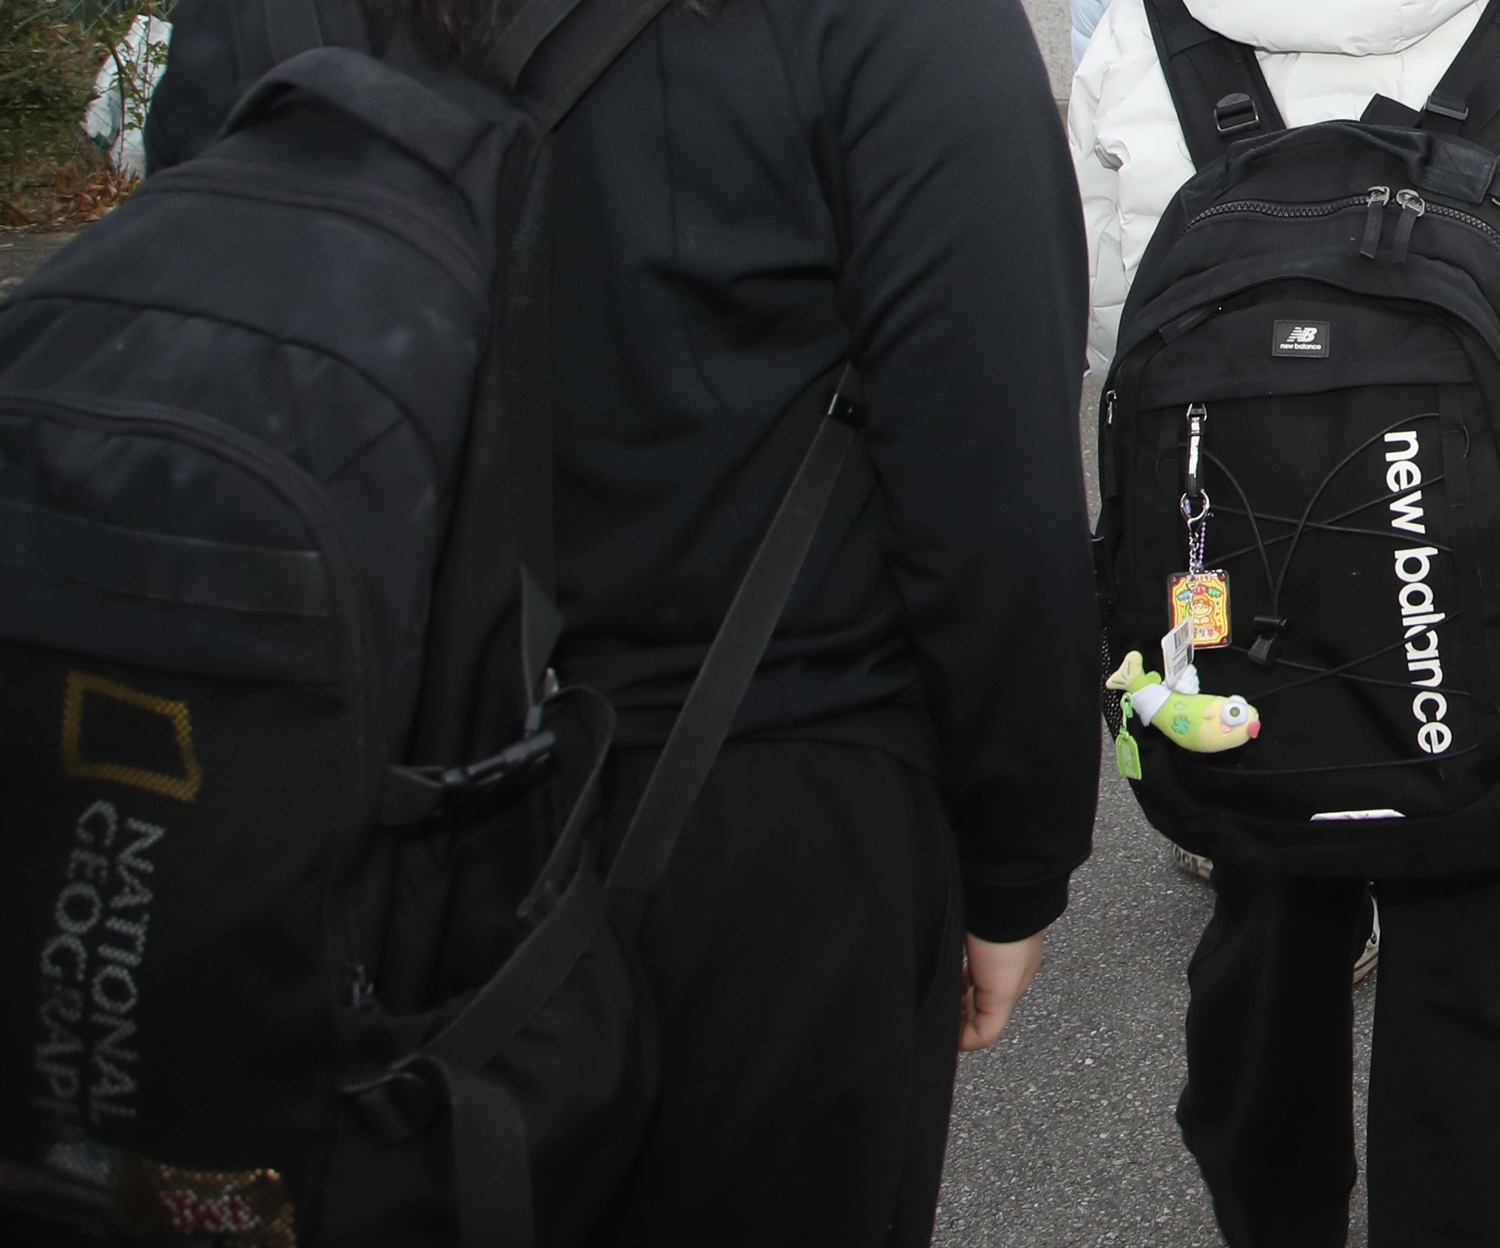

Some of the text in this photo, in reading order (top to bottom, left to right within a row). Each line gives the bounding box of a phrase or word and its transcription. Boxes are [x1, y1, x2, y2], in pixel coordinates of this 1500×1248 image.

[1294, 342, 1322, 350] balance
[1384, 430, 1452, 754] new balance
[90, 817, 167, 1123] NATIONAL
